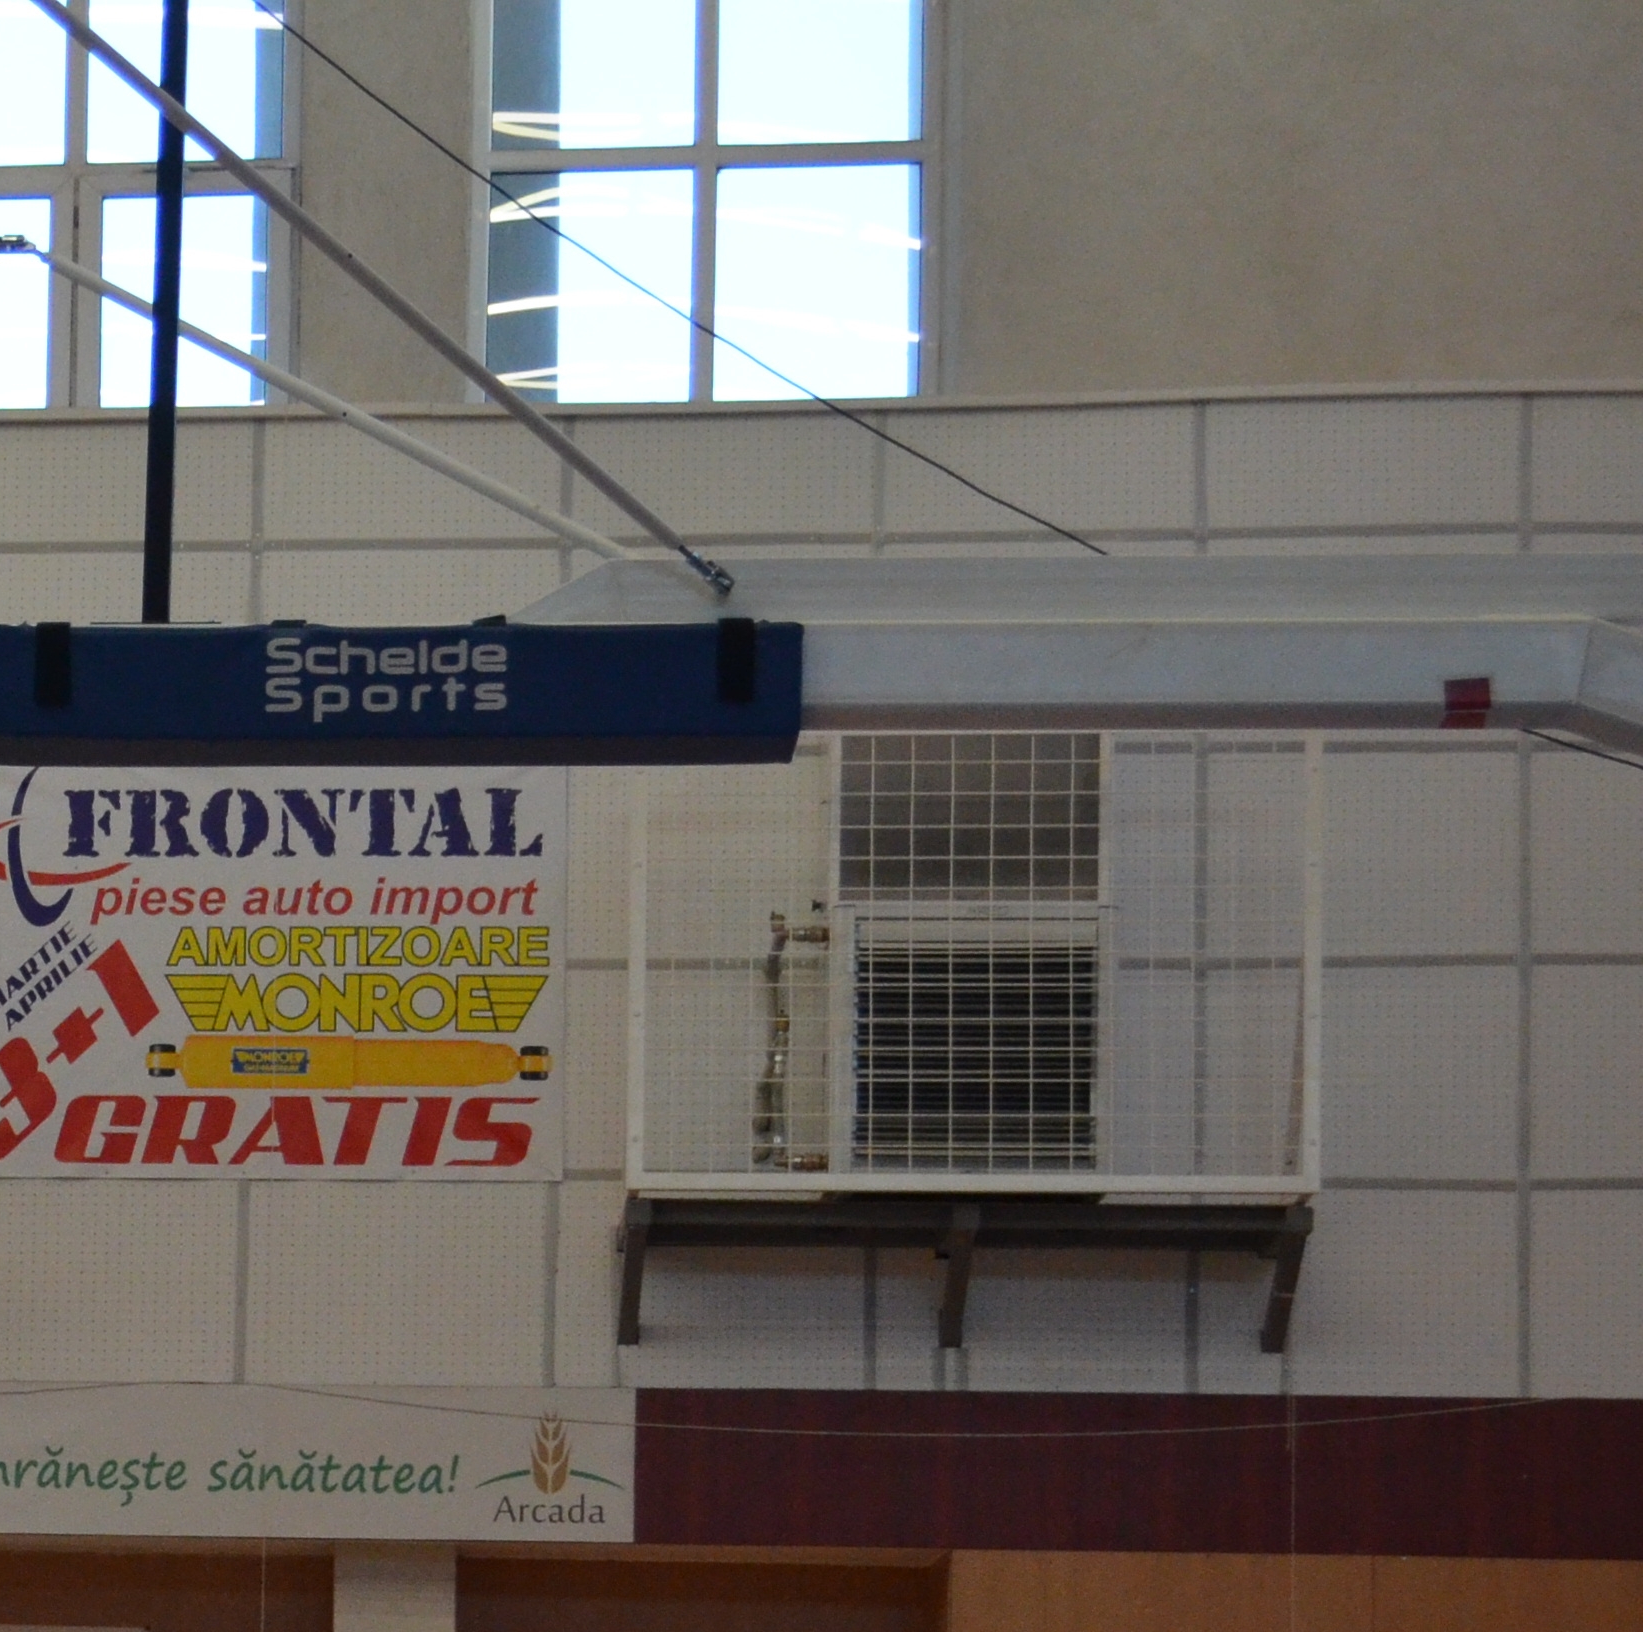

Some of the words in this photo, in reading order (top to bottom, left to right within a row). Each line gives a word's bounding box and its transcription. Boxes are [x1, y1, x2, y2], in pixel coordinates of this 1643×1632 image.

[265, 637, 507, 675] Schelde
[265, 676, 508, 723] Sports
[62, 788, 544, 858] FRONTAL
[89, 877, 226, 925] piese
[242, 879, 355, 917] auto
[369, 877, 538, 925] import
[167, 926, 551, 968] AMORTIZOARE
[5, 933, 97, 1031] APRILIE
[212, 974, 497, 1033] MONROE
[54, 1095, 540, 1167] GRATIS
[208, 1448, 460, 1494] sănătatea!
[493, 1494, 606, 1524] Arcada
